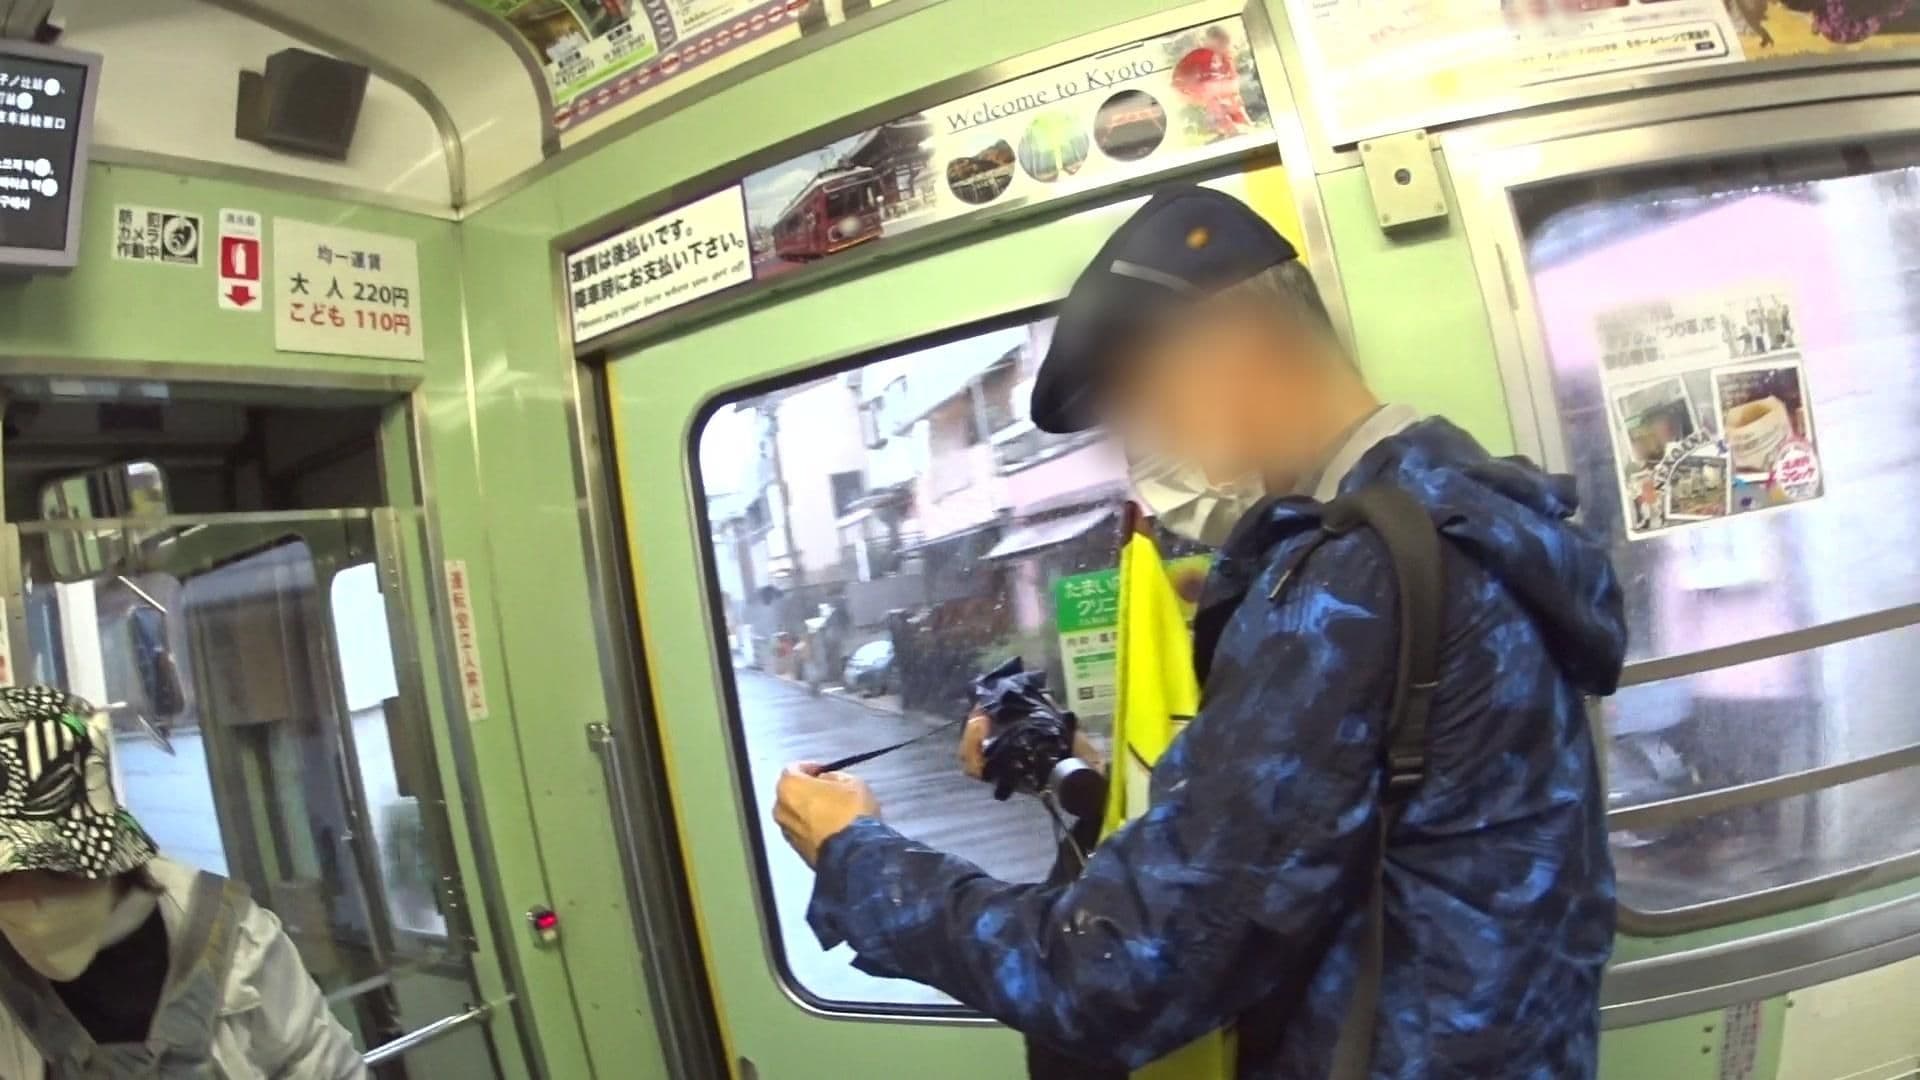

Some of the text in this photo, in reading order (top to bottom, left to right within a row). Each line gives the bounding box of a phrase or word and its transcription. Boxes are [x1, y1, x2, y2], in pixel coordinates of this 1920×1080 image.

[947, 59, 1155, 130] Welcome to Kyoto
[120, 226, 161, 243] カメラ
[118, 242, 160, 260] 作動中
[317, 244, 381, 271] 均一運賃
[571, 218, 693, 283] 運賃は後払いです。
[574, 232, 745, 312] 降車時にお支払い下さい。
[353, 281, 409, 308] 220円
[290, 302, 411, 336] こども 110円
